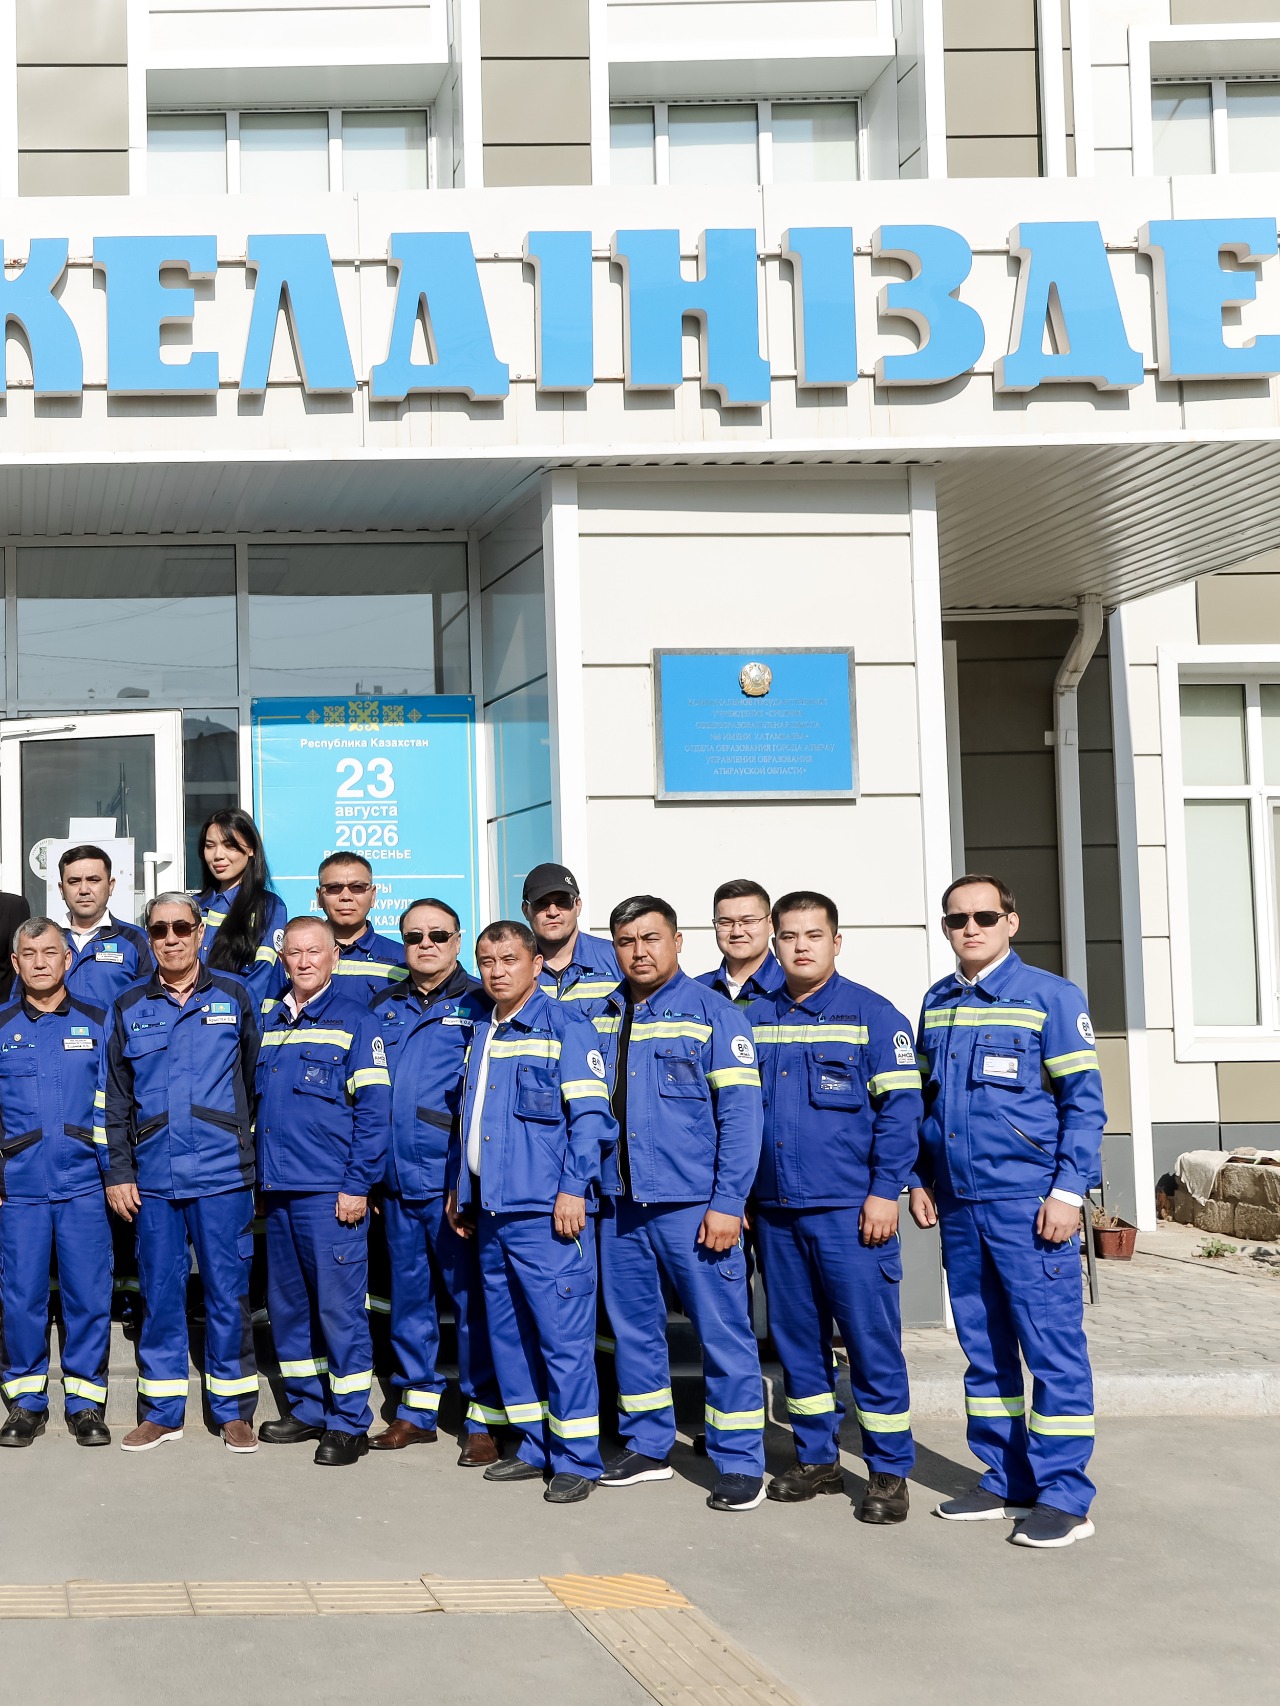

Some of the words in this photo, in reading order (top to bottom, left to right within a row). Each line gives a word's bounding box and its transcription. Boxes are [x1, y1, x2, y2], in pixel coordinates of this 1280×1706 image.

[300, 738, 367, 750] Республика
[370, 738, 429, 748] Казахстан
[335, 757, 395, 799] 23
[335, 805, 398, 820] августа
[335, 825, 399, 847] 2026
[323, 849, 412, 860] ВРЕСЕНЬЕ
